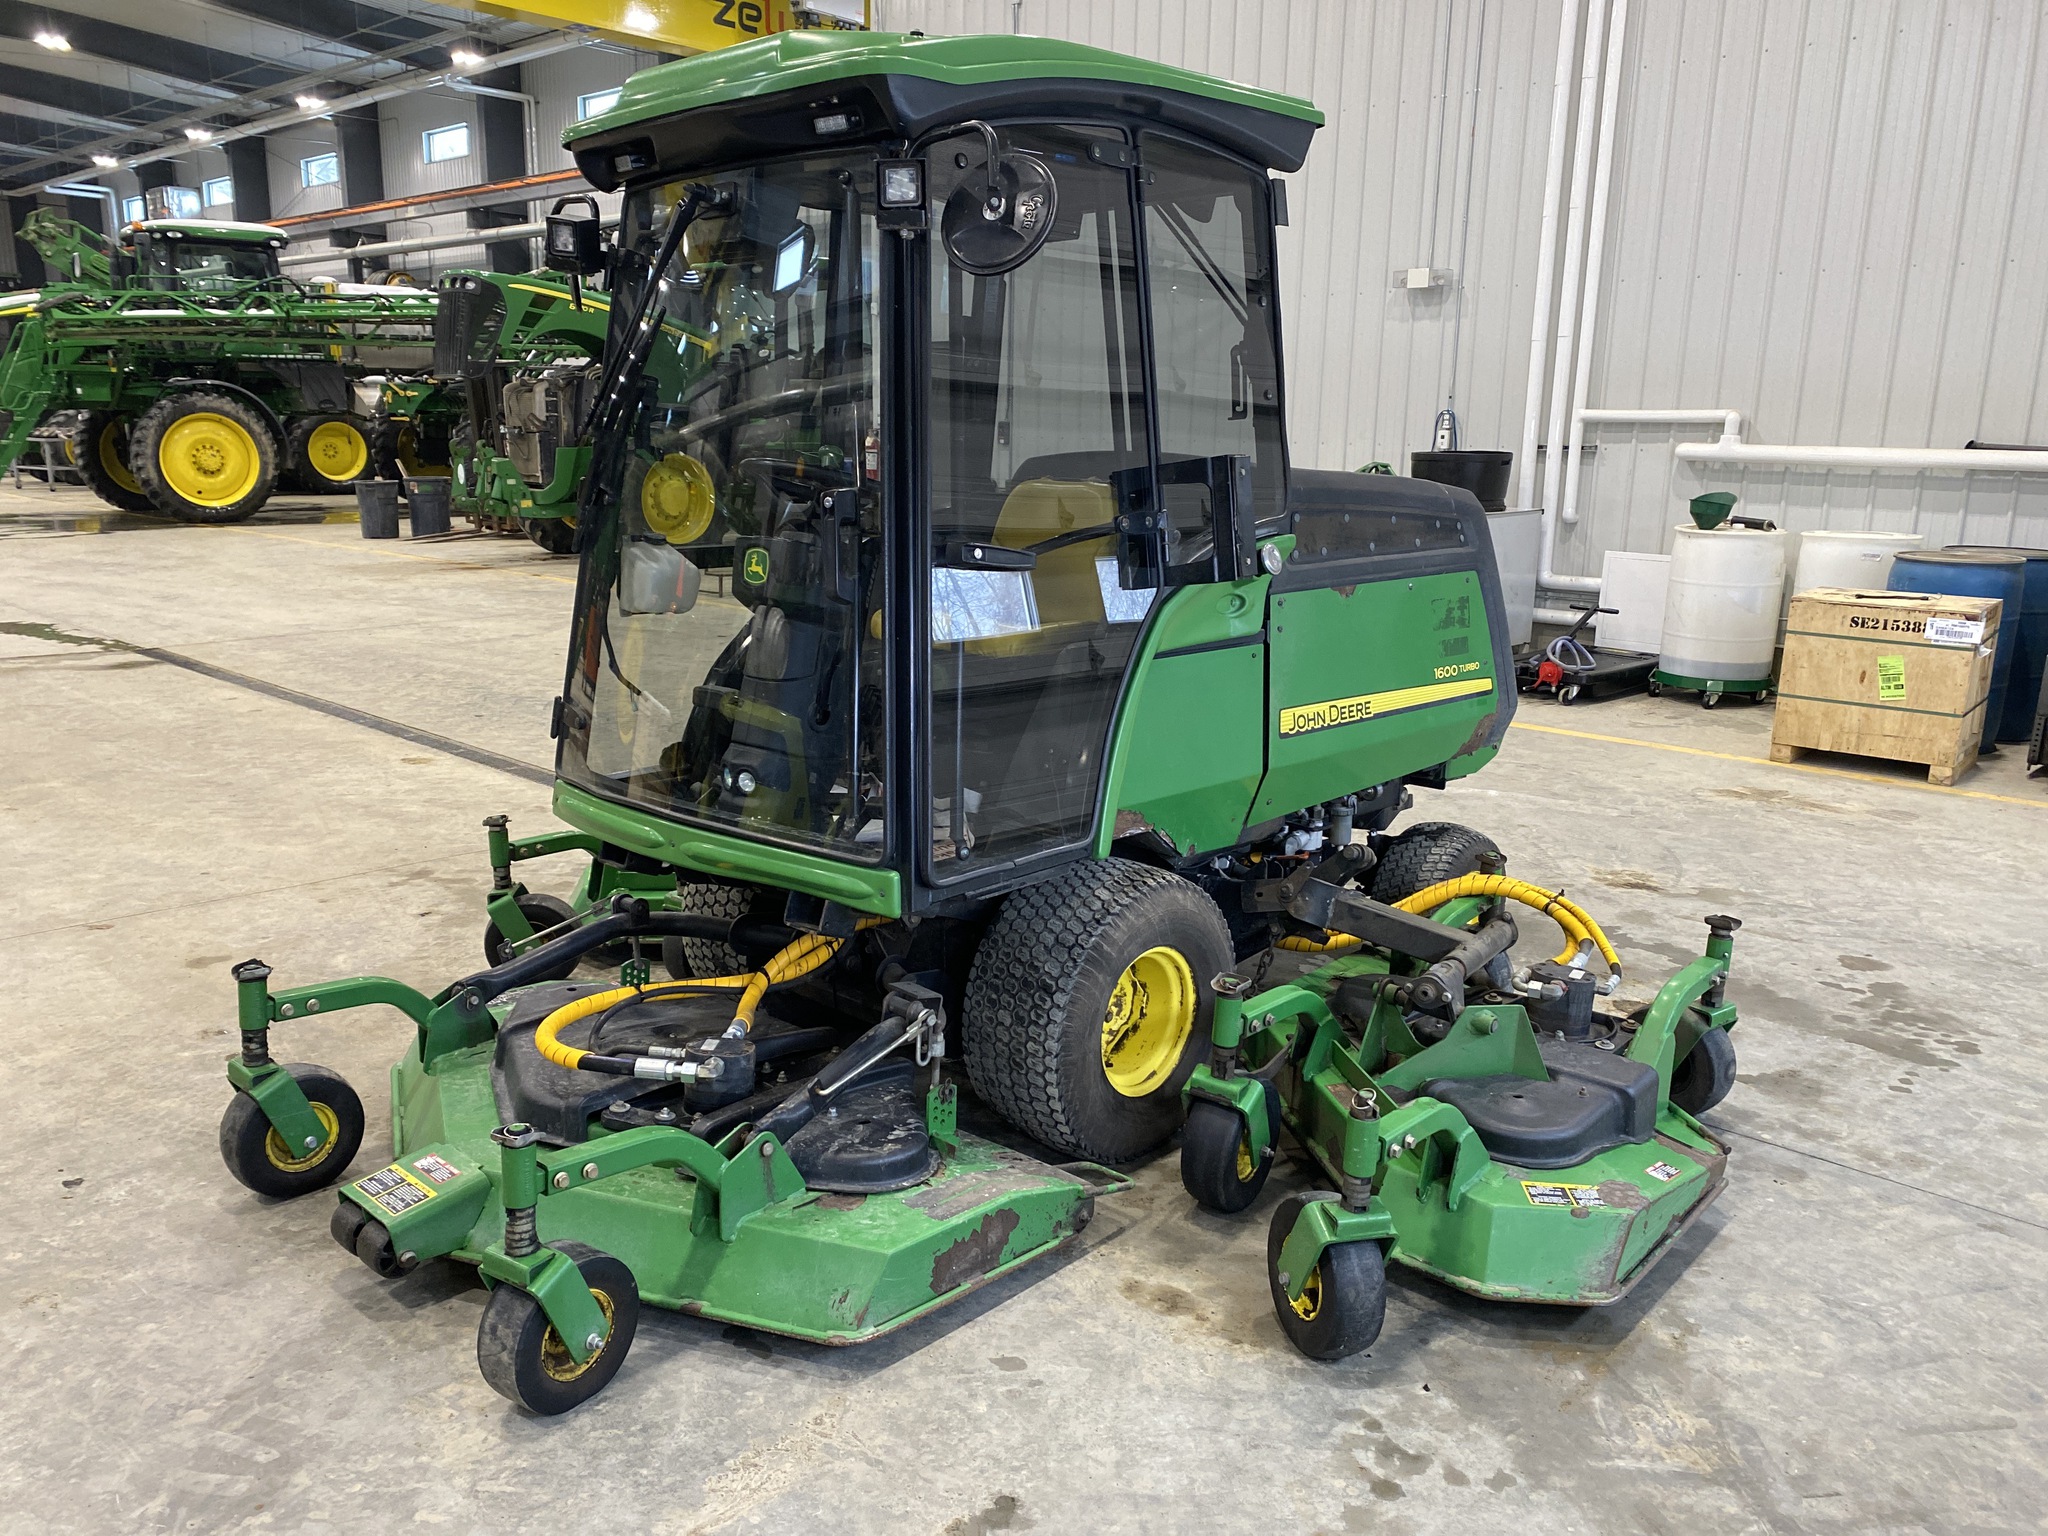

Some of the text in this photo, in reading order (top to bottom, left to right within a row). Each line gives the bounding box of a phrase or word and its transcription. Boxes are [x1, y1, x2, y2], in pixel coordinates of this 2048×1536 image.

[1849, 616, 1927, 633] SE21538
[1434, 662, 1480, 679] 1600 TURBO
[1288, 701, 1372, 732] JOHN DEERE
